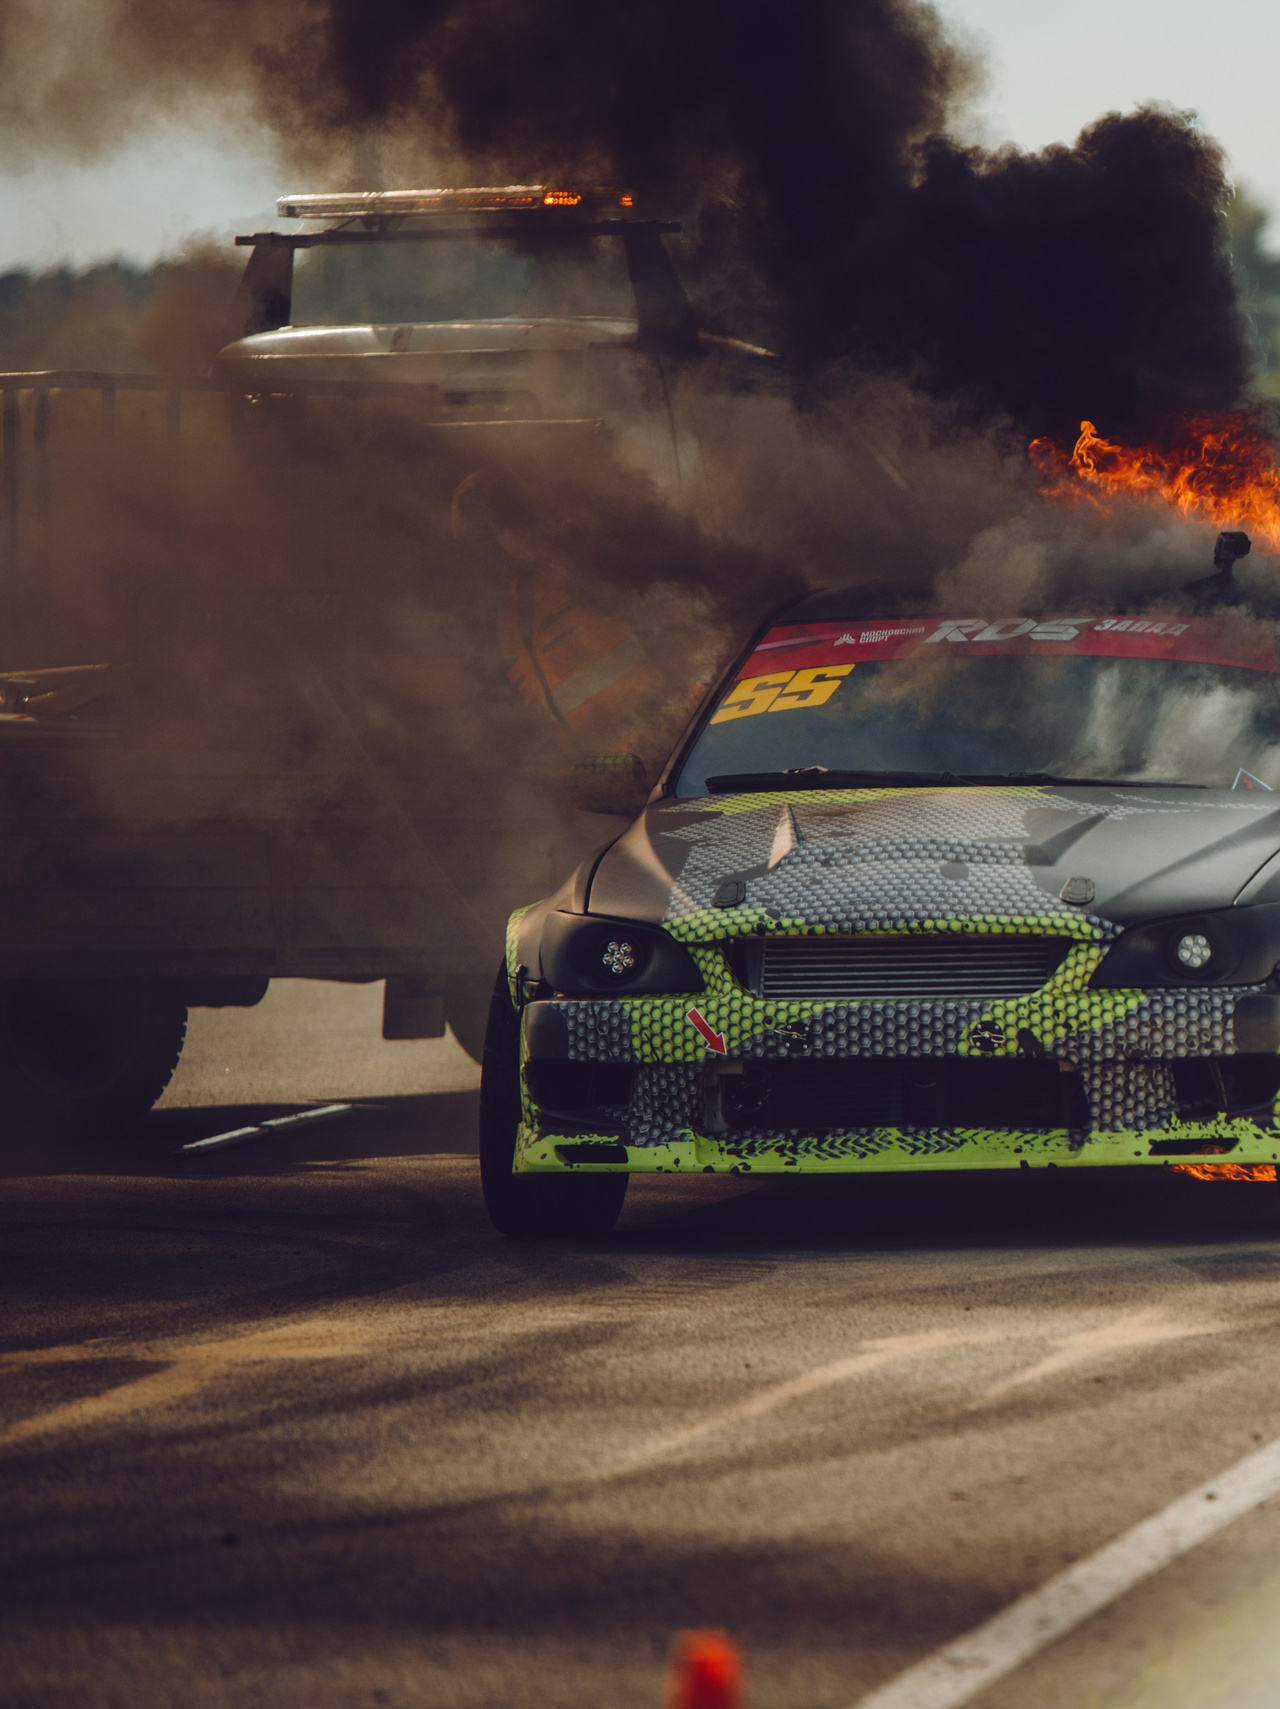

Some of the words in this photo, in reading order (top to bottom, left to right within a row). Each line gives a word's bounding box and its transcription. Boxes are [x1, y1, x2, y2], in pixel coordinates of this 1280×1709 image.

[859, 635, 890, 644] СПОРТ
[860, 626, 925, 639] МОСКОВСКИЙ
[923, 617, 1097, 643] RDS
[1094, 619, 1191, 637] ЗАПАД
[710, 663, 856, 725] 55
